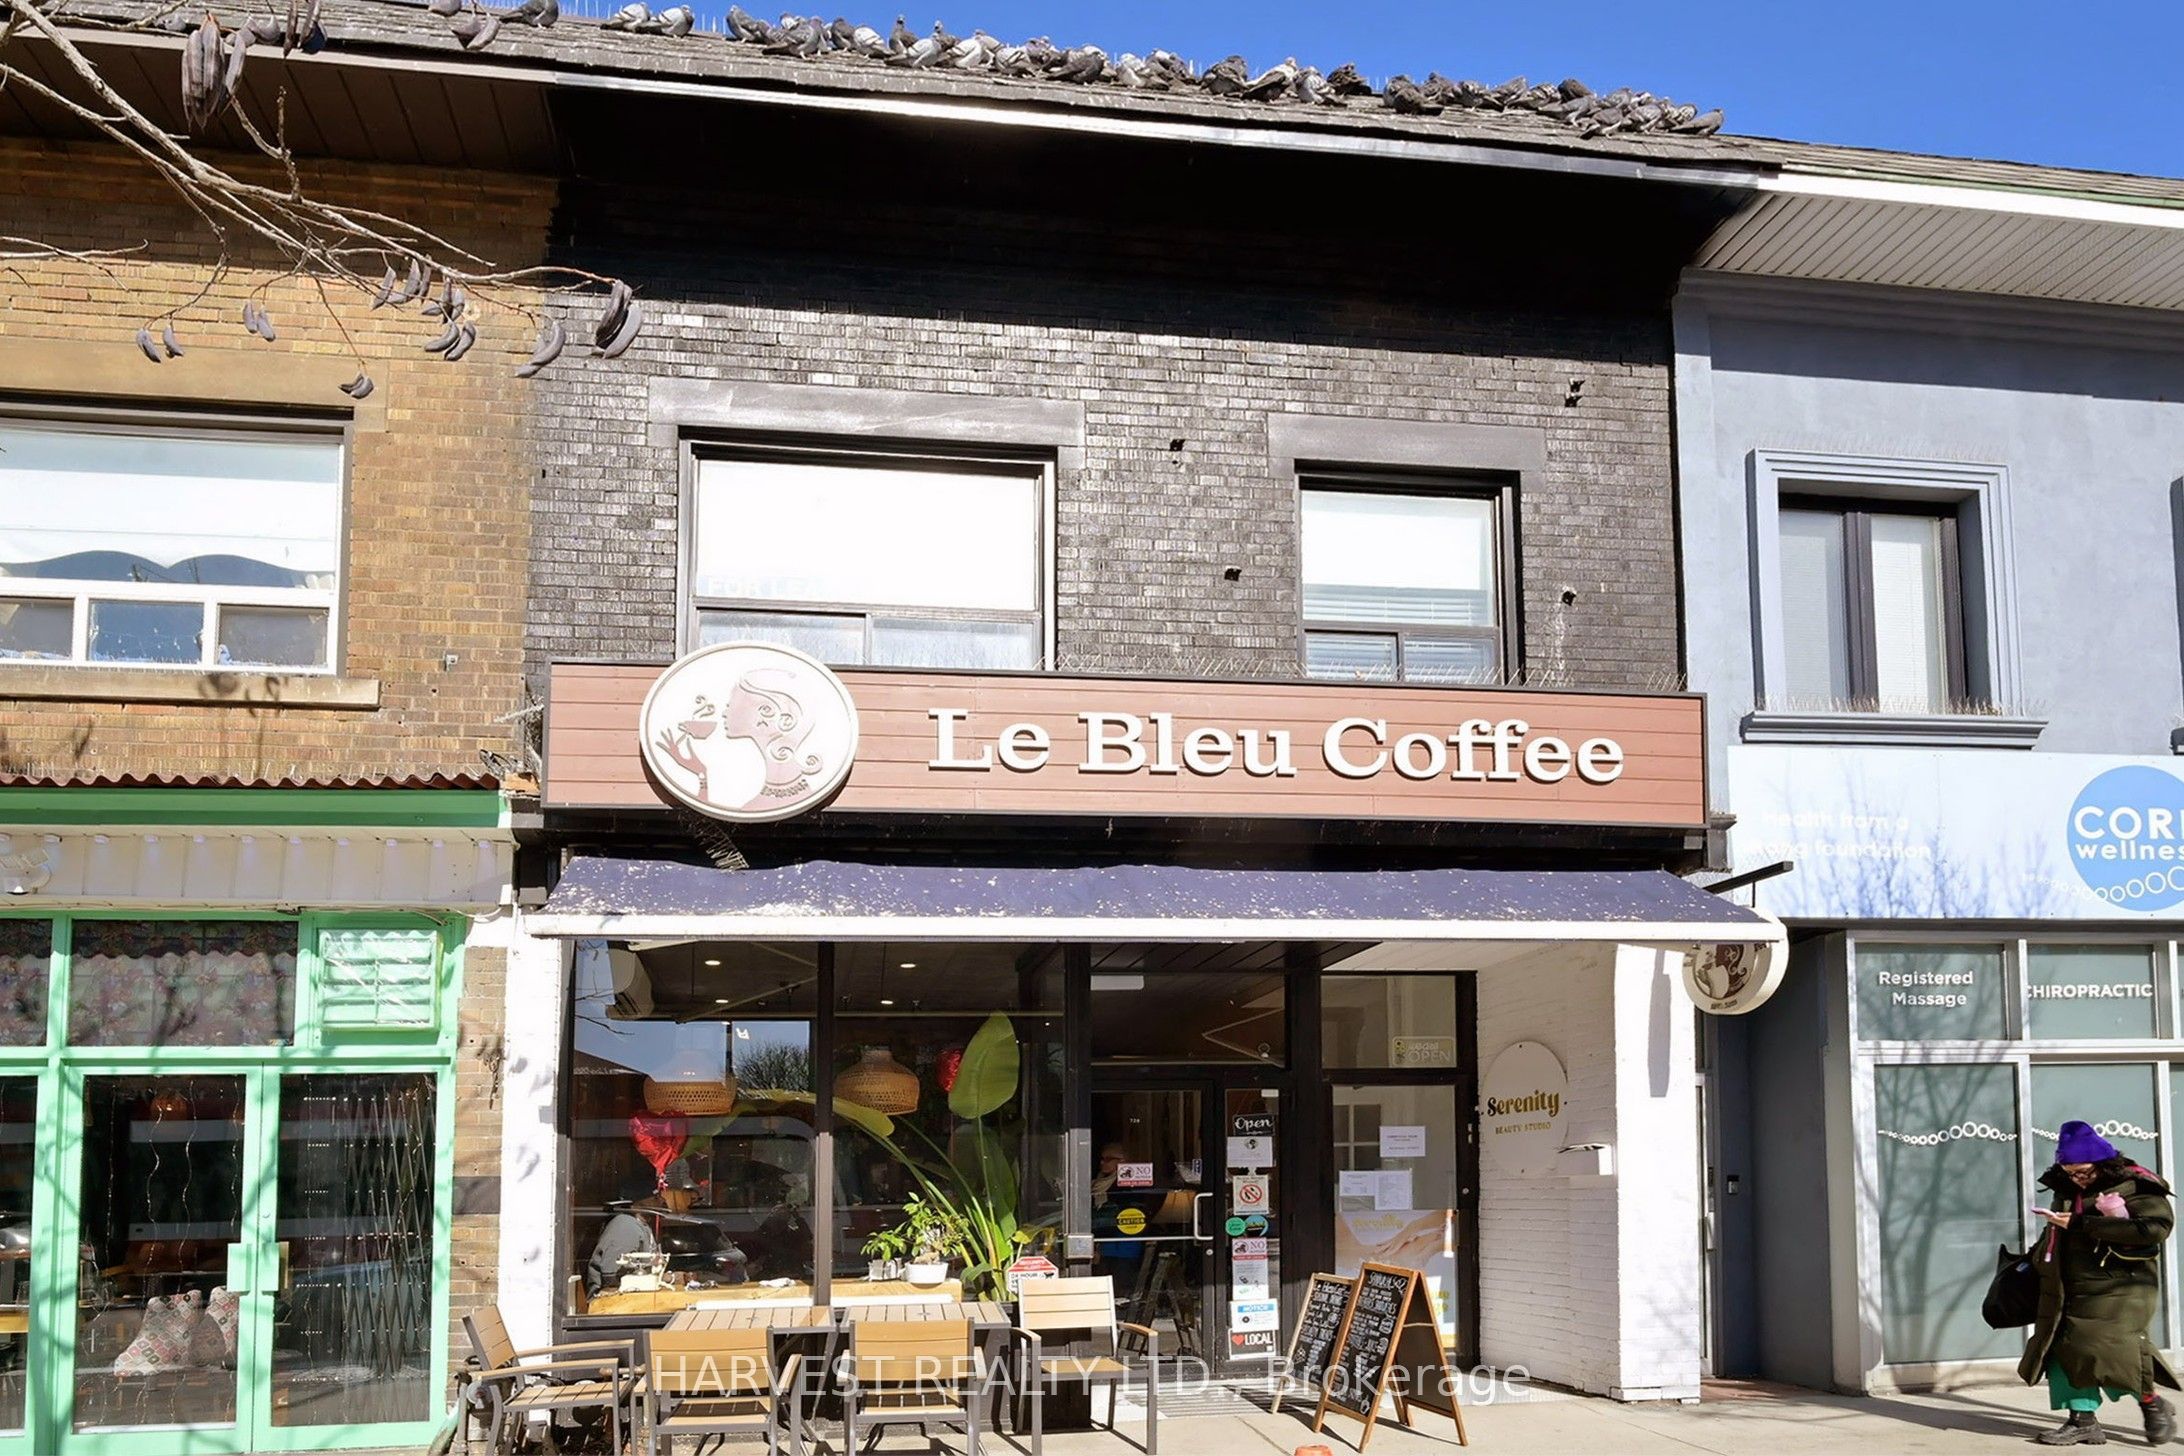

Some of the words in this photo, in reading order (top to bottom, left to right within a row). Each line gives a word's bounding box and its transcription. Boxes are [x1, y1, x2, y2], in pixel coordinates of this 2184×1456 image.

[927, 706, 1050, 772] Le
[1078, 710, 1298, 778] Bleu
[1323, 716, 1626, 784] Coffee
[1814, 838, 1932, 861] foundation
[1878, 971, 1974, 988] Registered
[1892, 992, 1967, 1009] Massage
[1487, 1090, 1560, 1118] Serenity
[1234, 1117, 1273, 1131] Open
[1495, 1123, 1522, 1135] BEAUTY
[1524, 1121, 1552, 1132] STUDIO
[1136, 1166, 1152, 1176] NO
[1250, 1240, 1266, 1250] NO
[1244, 1332, 1273, 1346] LOCAL
